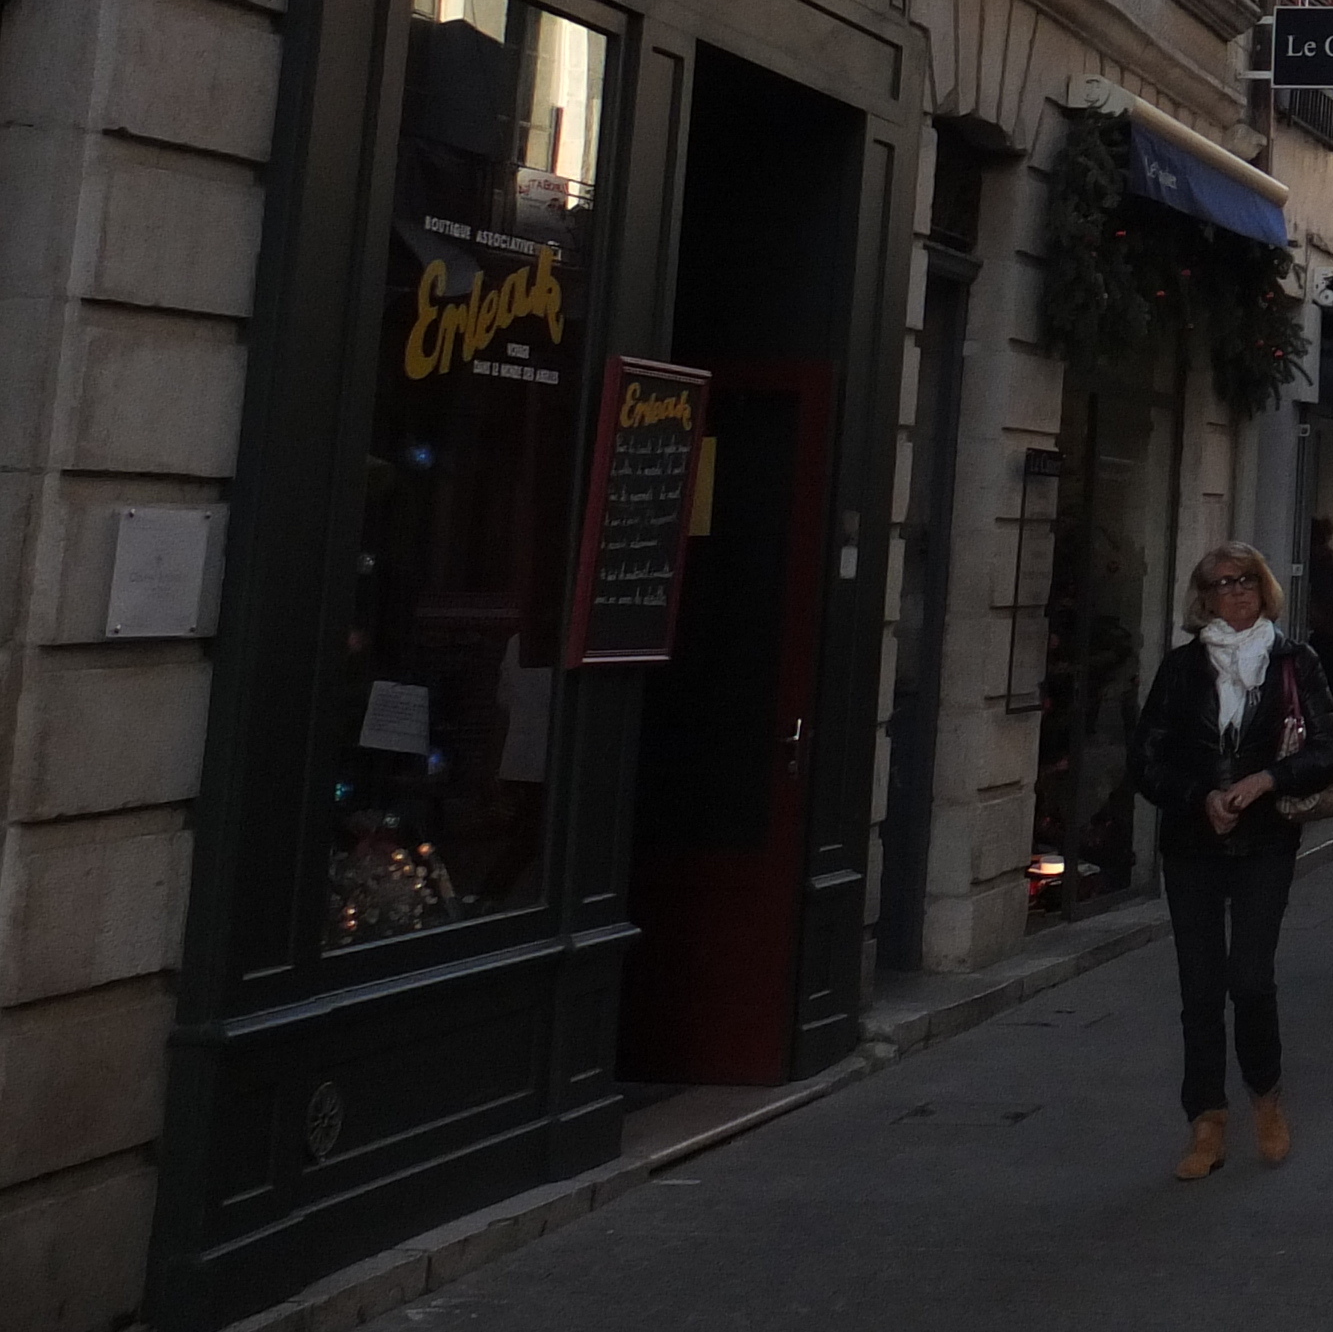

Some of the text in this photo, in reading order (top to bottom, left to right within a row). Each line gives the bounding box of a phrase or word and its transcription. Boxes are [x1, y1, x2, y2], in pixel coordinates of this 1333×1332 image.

[1286, 34, 1317, 57] Le
[424, 215, 472, 241] BOUTIQUE
[404, 245, 566, 381] Erleak
